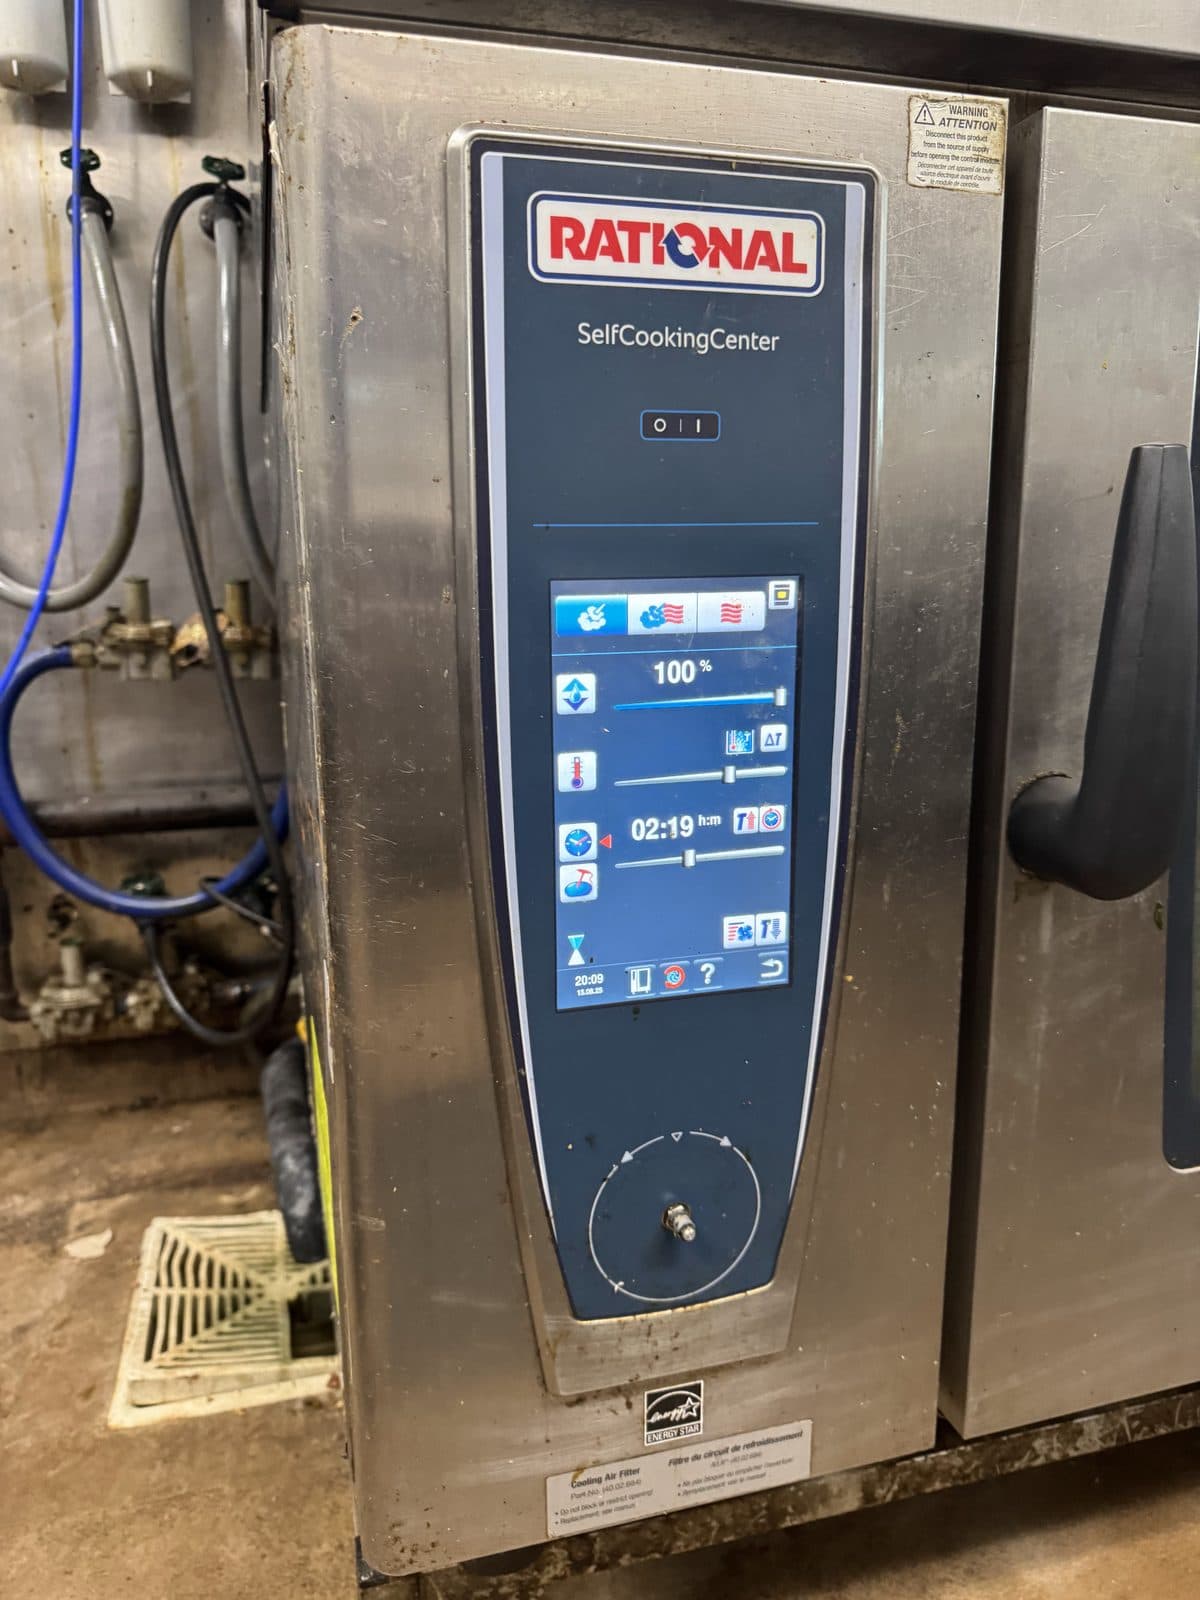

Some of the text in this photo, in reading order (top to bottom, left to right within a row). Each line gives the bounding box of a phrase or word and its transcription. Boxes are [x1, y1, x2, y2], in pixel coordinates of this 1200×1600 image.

[949, 104, 989, 118] WARNING
[938, 117, 998, 131] ATTENTION
[925, 130, 988, 143] Disconnect this product
[911, 150, 928, 158] before
[928, 152, 950, 161] opening
[951, 153, 959, 161] the
[972, 146, 990, 154] supply
[550, 215, 808, 275] RATIONAL
[577, 322, 780, 354] SelfCookingCenter
[654, 659, 713, 684] 100 %
[631, 813, 722, 841] 02:19 h:m
[575, 973, 604, 987] 20:09
[647, 1424, 700, 1443] ENERGY STAR
[668, 1456, 690, 1467] Filtre
[691, 1453, 702, 1462] du
[703, 1446, 730, 1459] circuit
[731, 1444, 741, 1453] de
[571, 1467, 640, 1489] Cooling Air Filter
